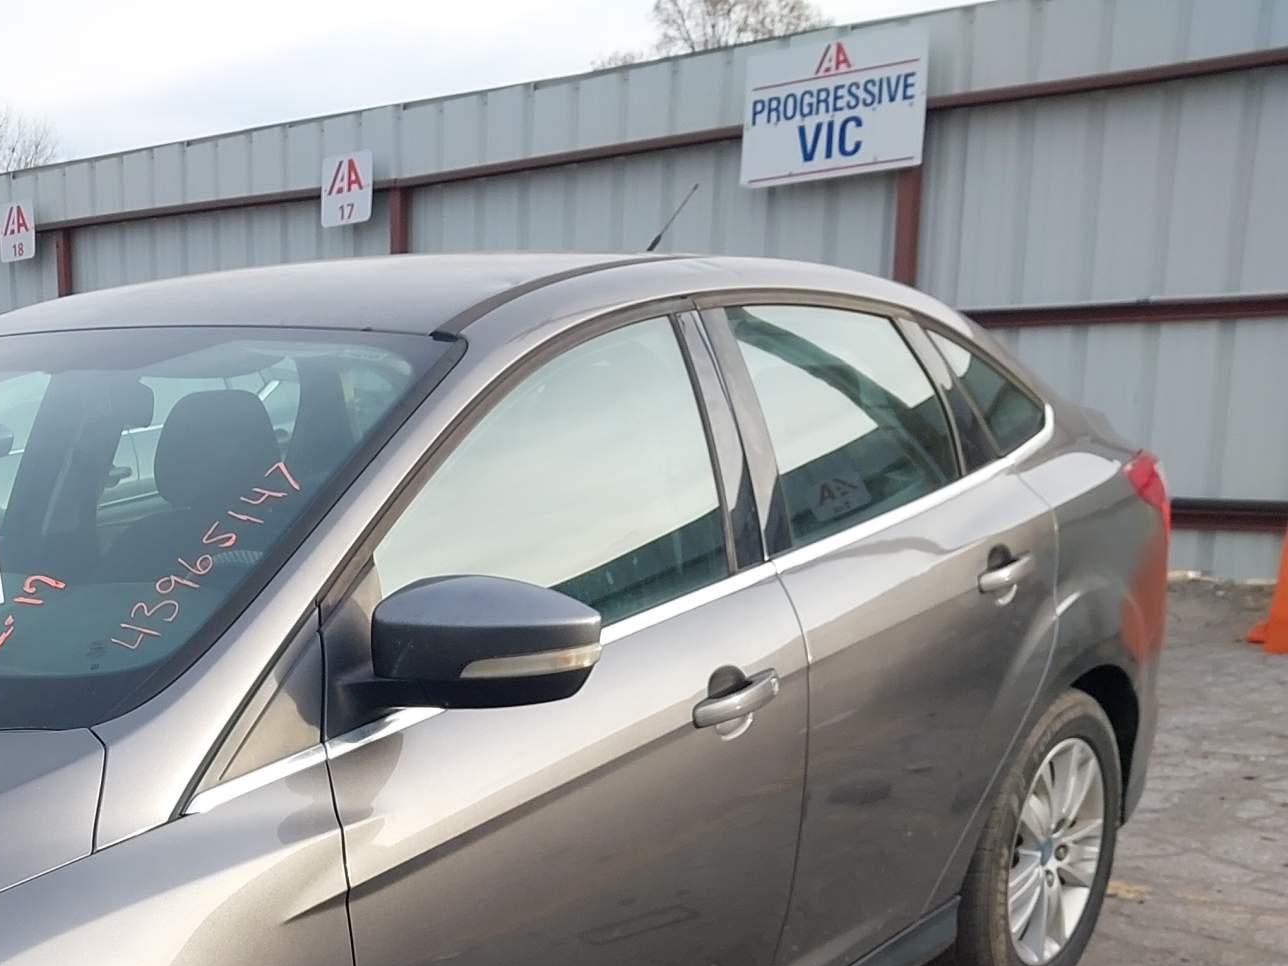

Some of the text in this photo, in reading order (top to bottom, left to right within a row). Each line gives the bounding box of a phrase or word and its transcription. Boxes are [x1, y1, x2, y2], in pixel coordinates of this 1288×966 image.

[751, 71, 916, 127] PROGRESSIVE
[797, 115, 864, 162] VIC
[338, 202, 355, 220] 17
[12, 242, 24, 257] 18
[111, 462, 300, 650] 43965147
